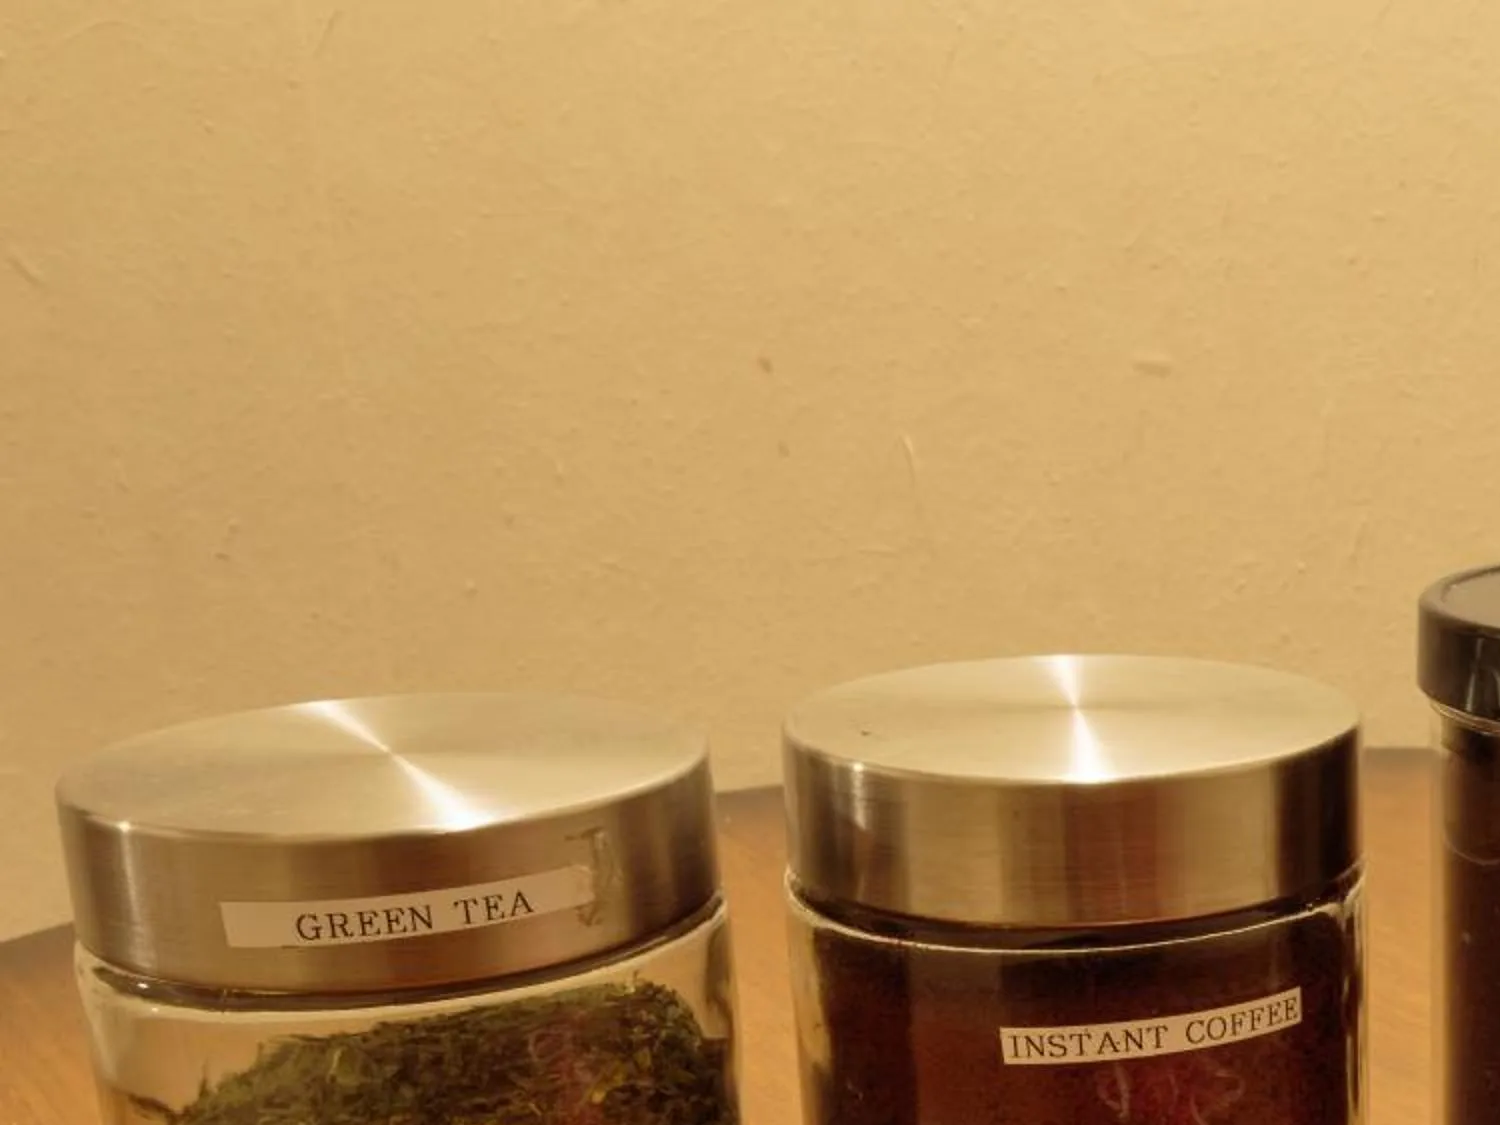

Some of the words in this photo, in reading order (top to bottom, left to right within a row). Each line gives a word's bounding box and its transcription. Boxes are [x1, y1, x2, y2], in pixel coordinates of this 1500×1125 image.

[296, 904, 434, 941] GREEN
[454, 889, 535, 925] TEA
[1008, 1024, 1168, 1058] INSTANT
[1185, 996, 1298, 1045] COFFEE
